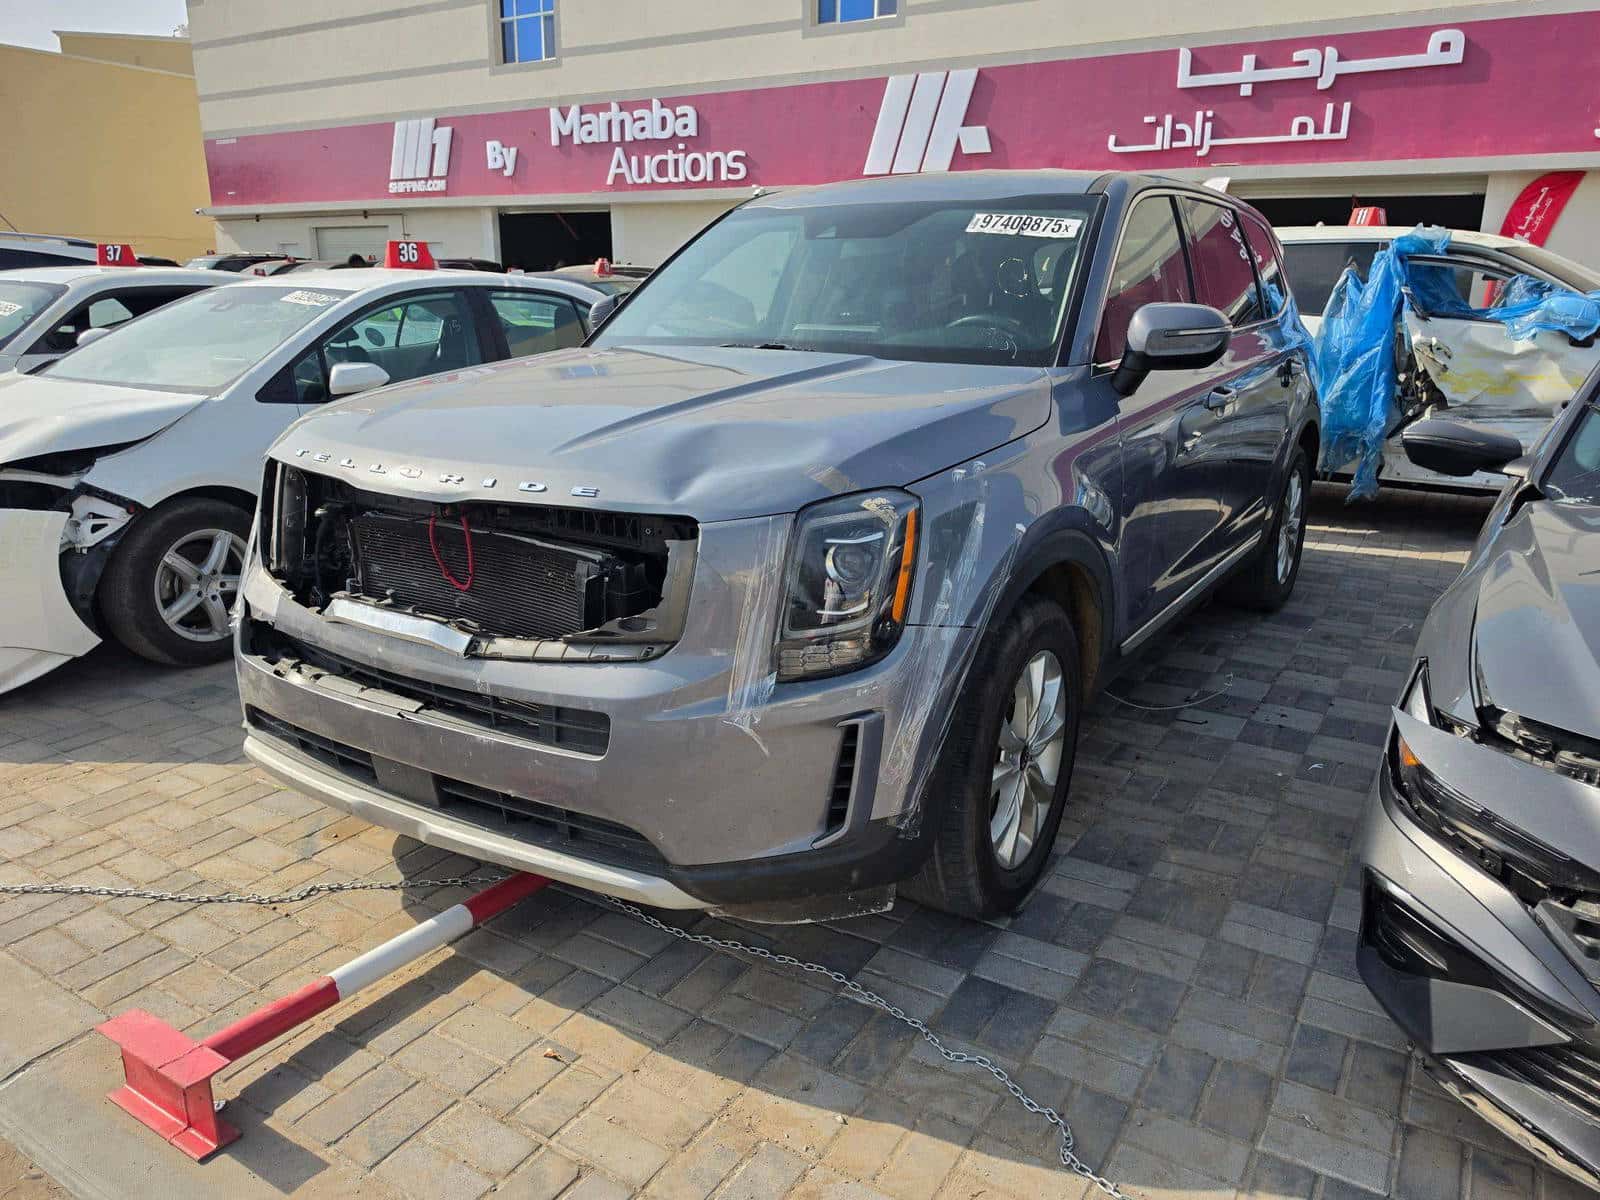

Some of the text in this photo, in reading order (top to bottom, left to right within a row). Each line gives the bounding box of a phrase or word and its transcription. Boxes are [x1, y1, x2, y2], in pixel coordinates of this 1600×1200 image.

[1177, 29, 1466, 96] مرحبا
[550, 98, 698, 146] Marhaba
[1108, 101, 1351, 156] للمزادات
[486, 140, 518, 177] By
[606, 143, 748, 185] Auctions
[105, 245, 121, 261] 37
[398, 242, 418, 262] 36
